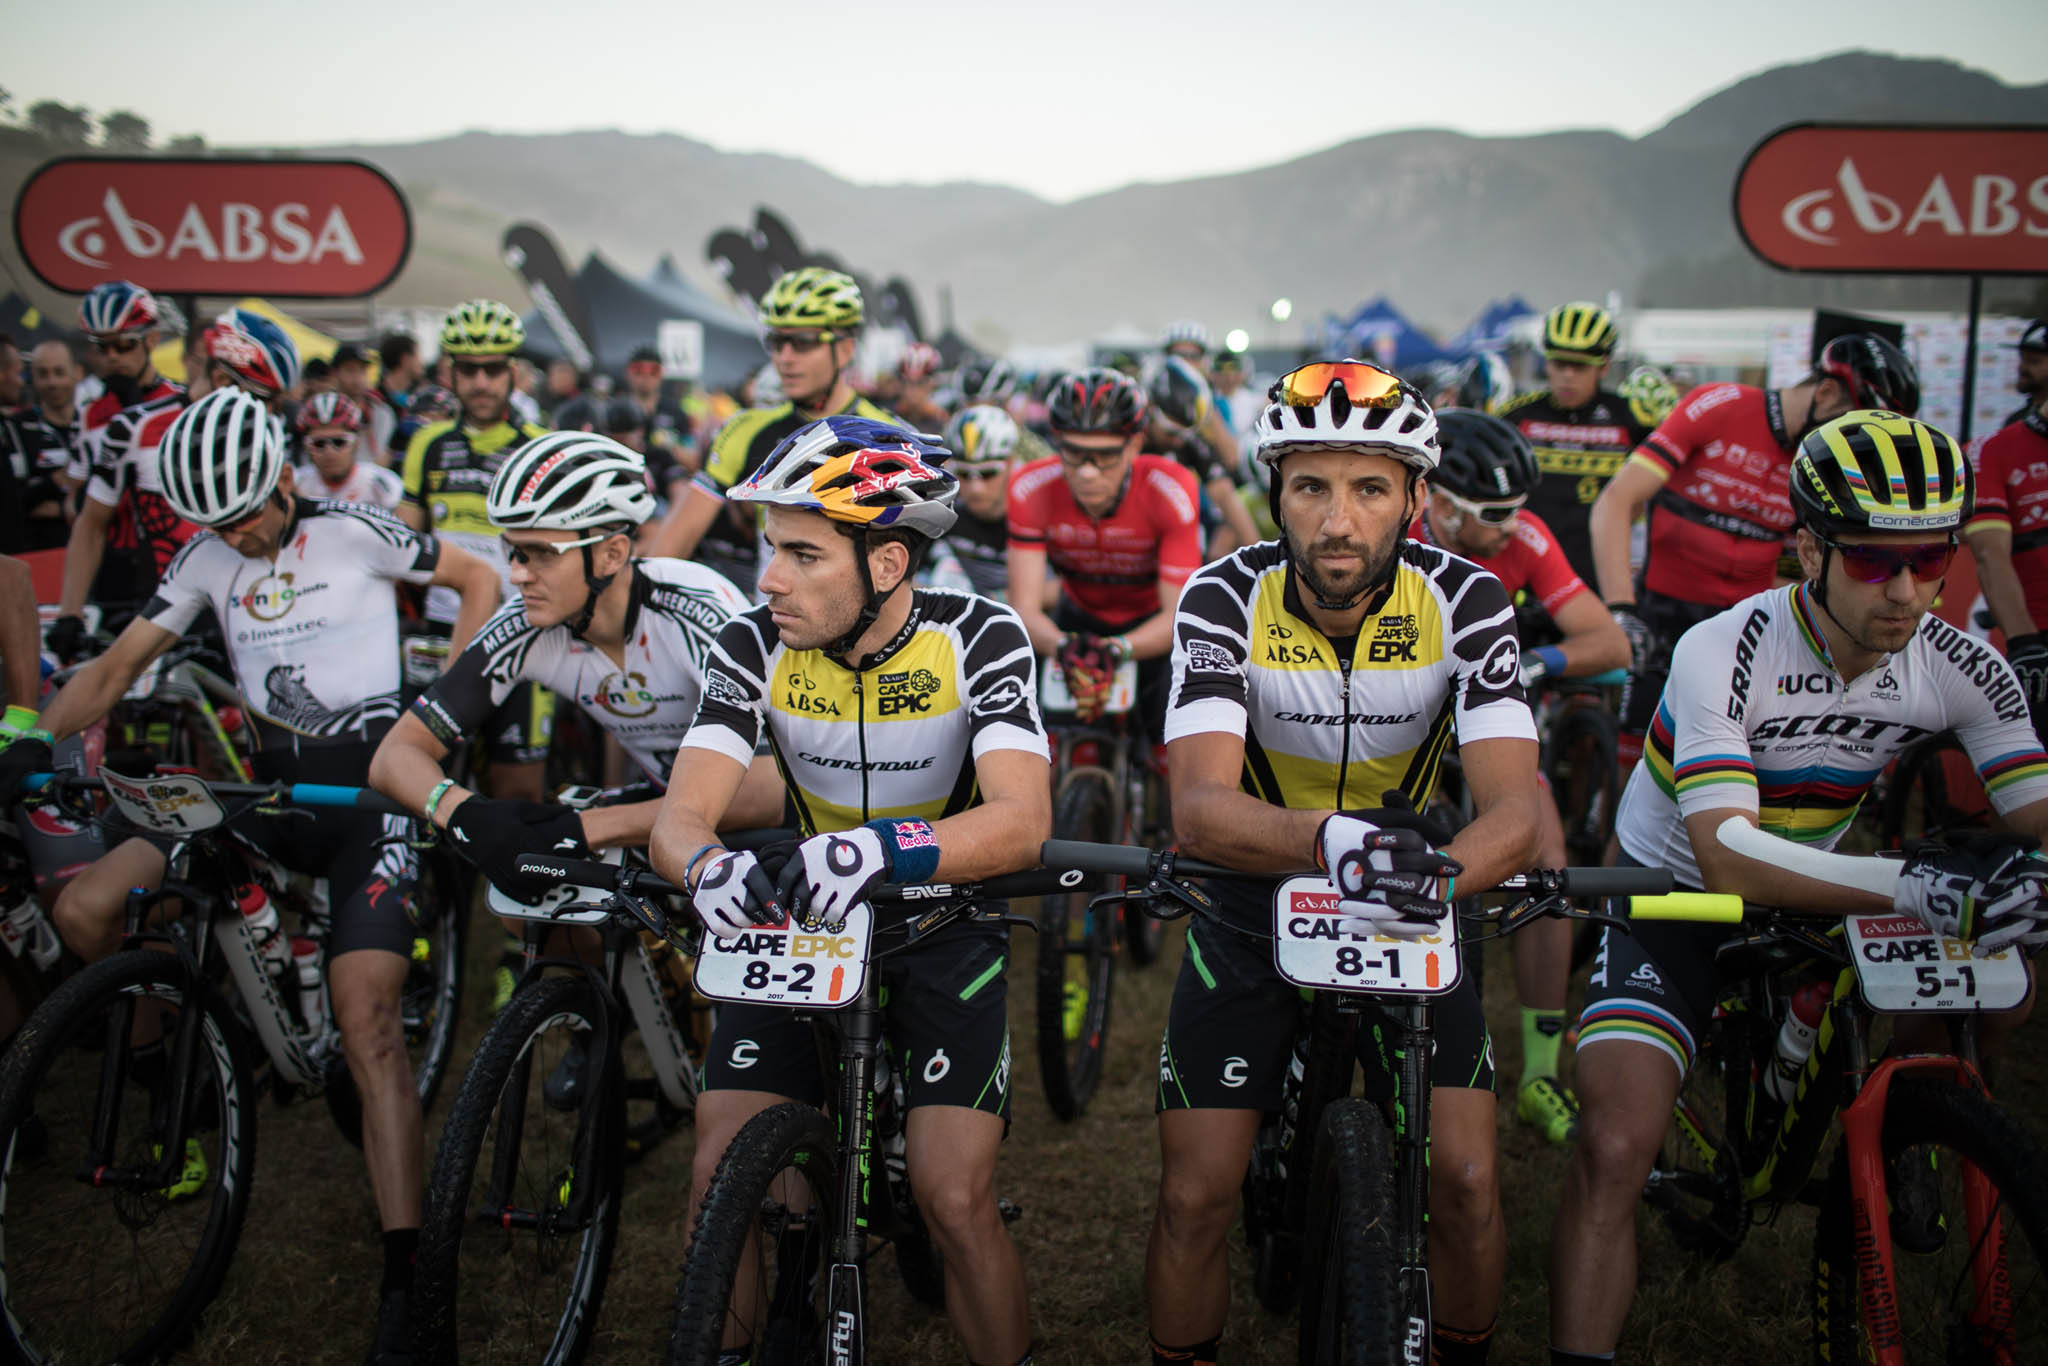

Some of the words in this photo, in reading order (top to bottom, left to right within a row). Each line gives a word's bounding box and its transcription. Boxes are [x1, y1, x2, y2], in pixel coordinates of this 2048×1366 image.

[1905, 173, 2048, 237] ABS
[167, 203, 364, 264] ABSA
[519, 451, 566, 503] STRABAG
[1802, 455, 1844, 517] SCOTT
[1190, 657, 1230, 671] EPIC
[1266, 645, 1324, 664] ABSA
[1368, 640, 1417, 662] EPIC
[1728, 608, 1770, 725] SRAM
[1921, 616, 2029, 725] ROCKSHOX
[878, 683, 910, 696] CAPE
[1785, 673, 1834, 696] UCI
[1870, 691, 1902, 701] odlo
[786, 691, 841, 716] ABSA
[878, 693, 932, 716] EPIC
[1748, 714, 1935, 744] SCOTT
[898, 835, 921, 849] Red
[520, 863, 567, 878] prologo
[1886, 919, 1926, 933] ABSA
[714, 933, 787, 957] CAPE
[791, 935, 855, 959] EPIC
[1863, 939, 1941, 963] CAPE
[1335, 946, 1401, 979] 8-1
[742, 960, 816, 993] 8-2
[1624, 979, 1665, 996] odlo
[1915, 966, 1976, 998] 5-1
[1856, 1235, 1900, 1350] ROCKSHOX
[1816, 1256, 1832, 1366] AXXIS
[832, 1310, 856, 1366] efty
